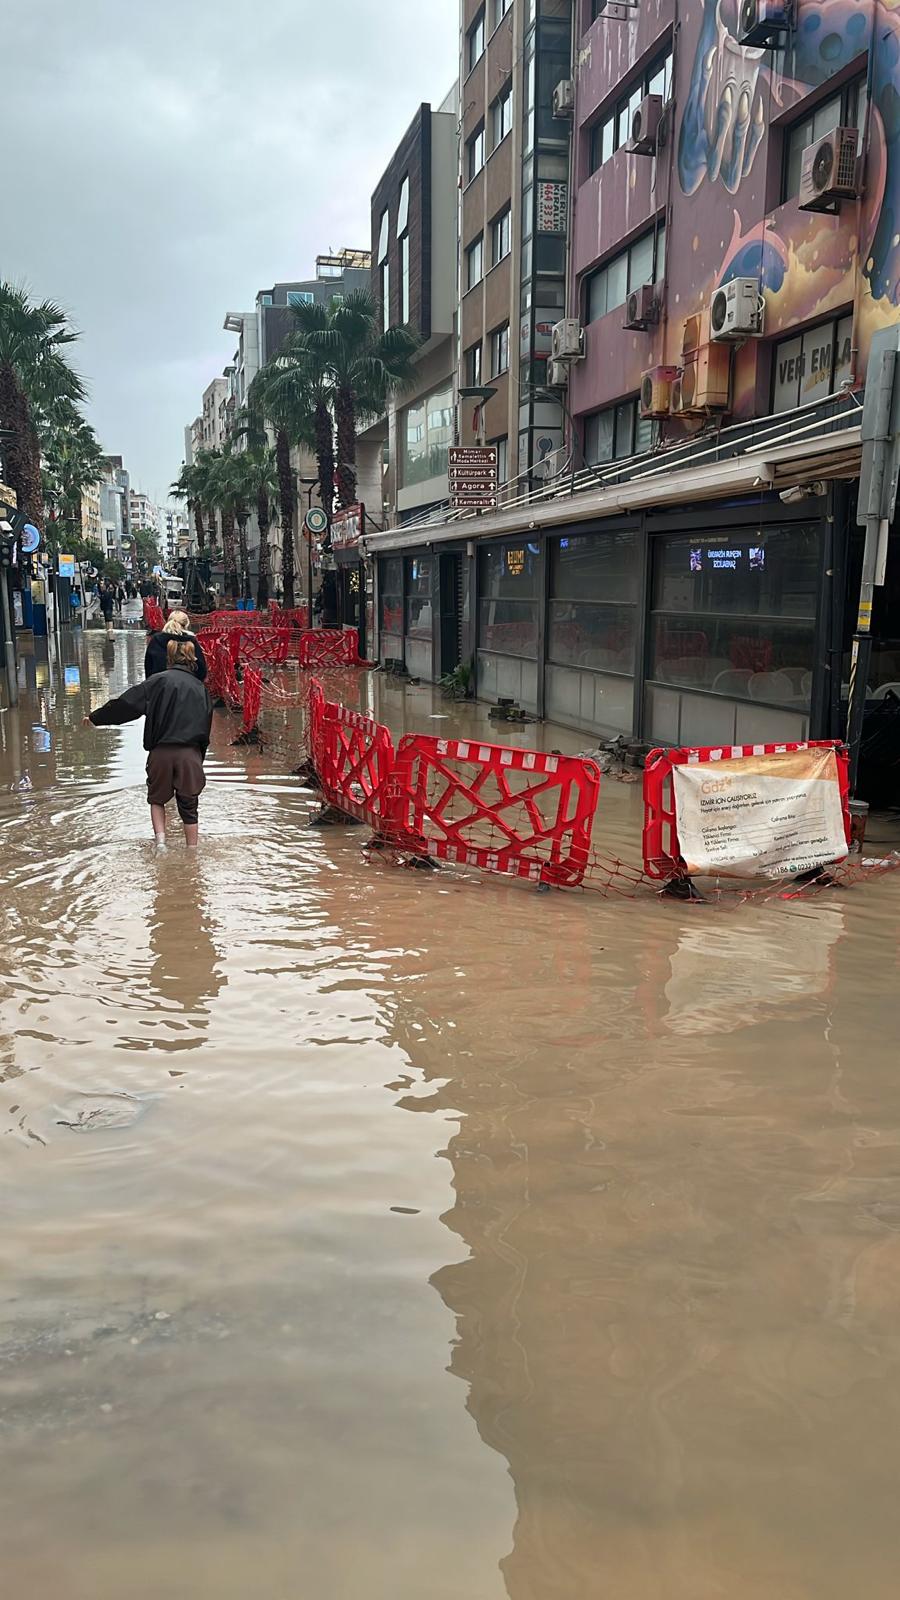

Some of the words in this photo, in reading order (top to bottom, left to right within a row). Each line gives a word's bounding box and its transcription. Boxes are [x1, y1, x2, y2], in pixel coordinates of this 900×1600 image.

[543, 204, 553, 216] 33
[543, 219, 553, 230] 55
[461, 482, 485, 490] Agora
[797, 863, 811, 871] 0232
